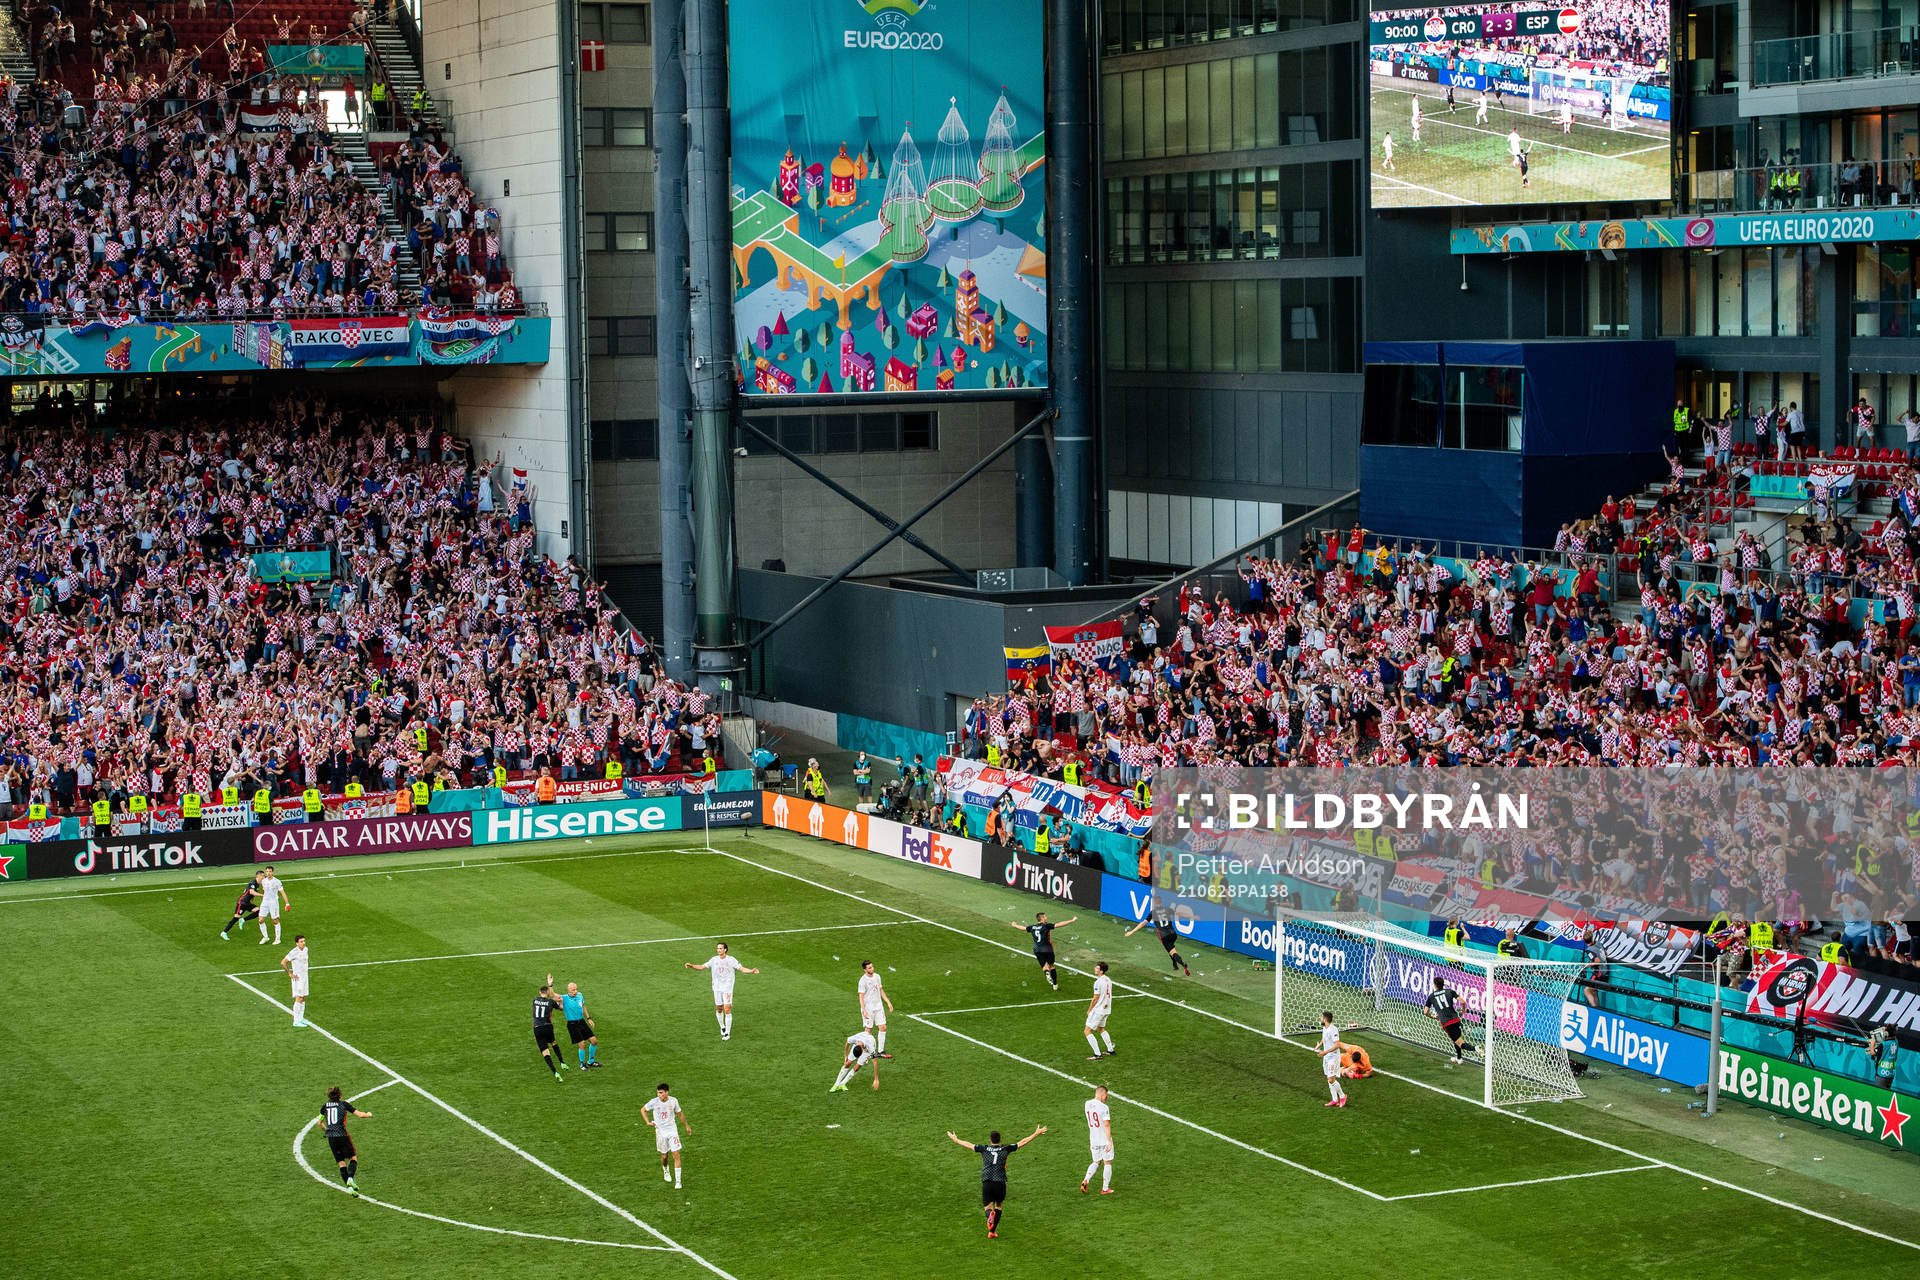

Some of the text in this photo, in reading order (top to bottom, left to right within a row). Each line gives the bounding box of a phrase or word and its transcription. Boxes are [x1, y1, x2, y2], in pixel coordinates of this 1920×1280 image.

[876, 14, 909, 28] UEFA
[1385, 25, 1418, 39] 90:00
[1452, 20, 1476, 35] CRO
[1526, 17, 1549, 29] ESP
[1408, 69, 1429, 82] TikTok
[1449, 71, 1476, 89] vivo
[1740, 216, 1874, 242] UEFA EURO 2020
[487, 806, 666, 842] Hisense
[716, 812, 740, 821] RESPECT
[255, 816, 472, 856] QATAR AIRWAYS
[901, 826, 953, 869] FedEx
[107, 840, 203, 870] TikTok
[1022, 863, 1073, 900] TikTok
[1130, 888, 1195, 934] vio
[1157, 913, 1169, 928] 15
[1241, 917, 1346, 971] Booking.com
[1436, 994, 1448, 1010] 14
[1811, 971, 1881, 1019] MI
[535, 1006, 546, 1018] 11
[1591, 1015, 1669, 1076] Alipay
[1718, 1049, 1876, 1134] Heineken
[326, 1107, 338, 1125] 10
[1086, 1111, 1100, 1128] 19
[990, 1151, 998, 1165] 7
